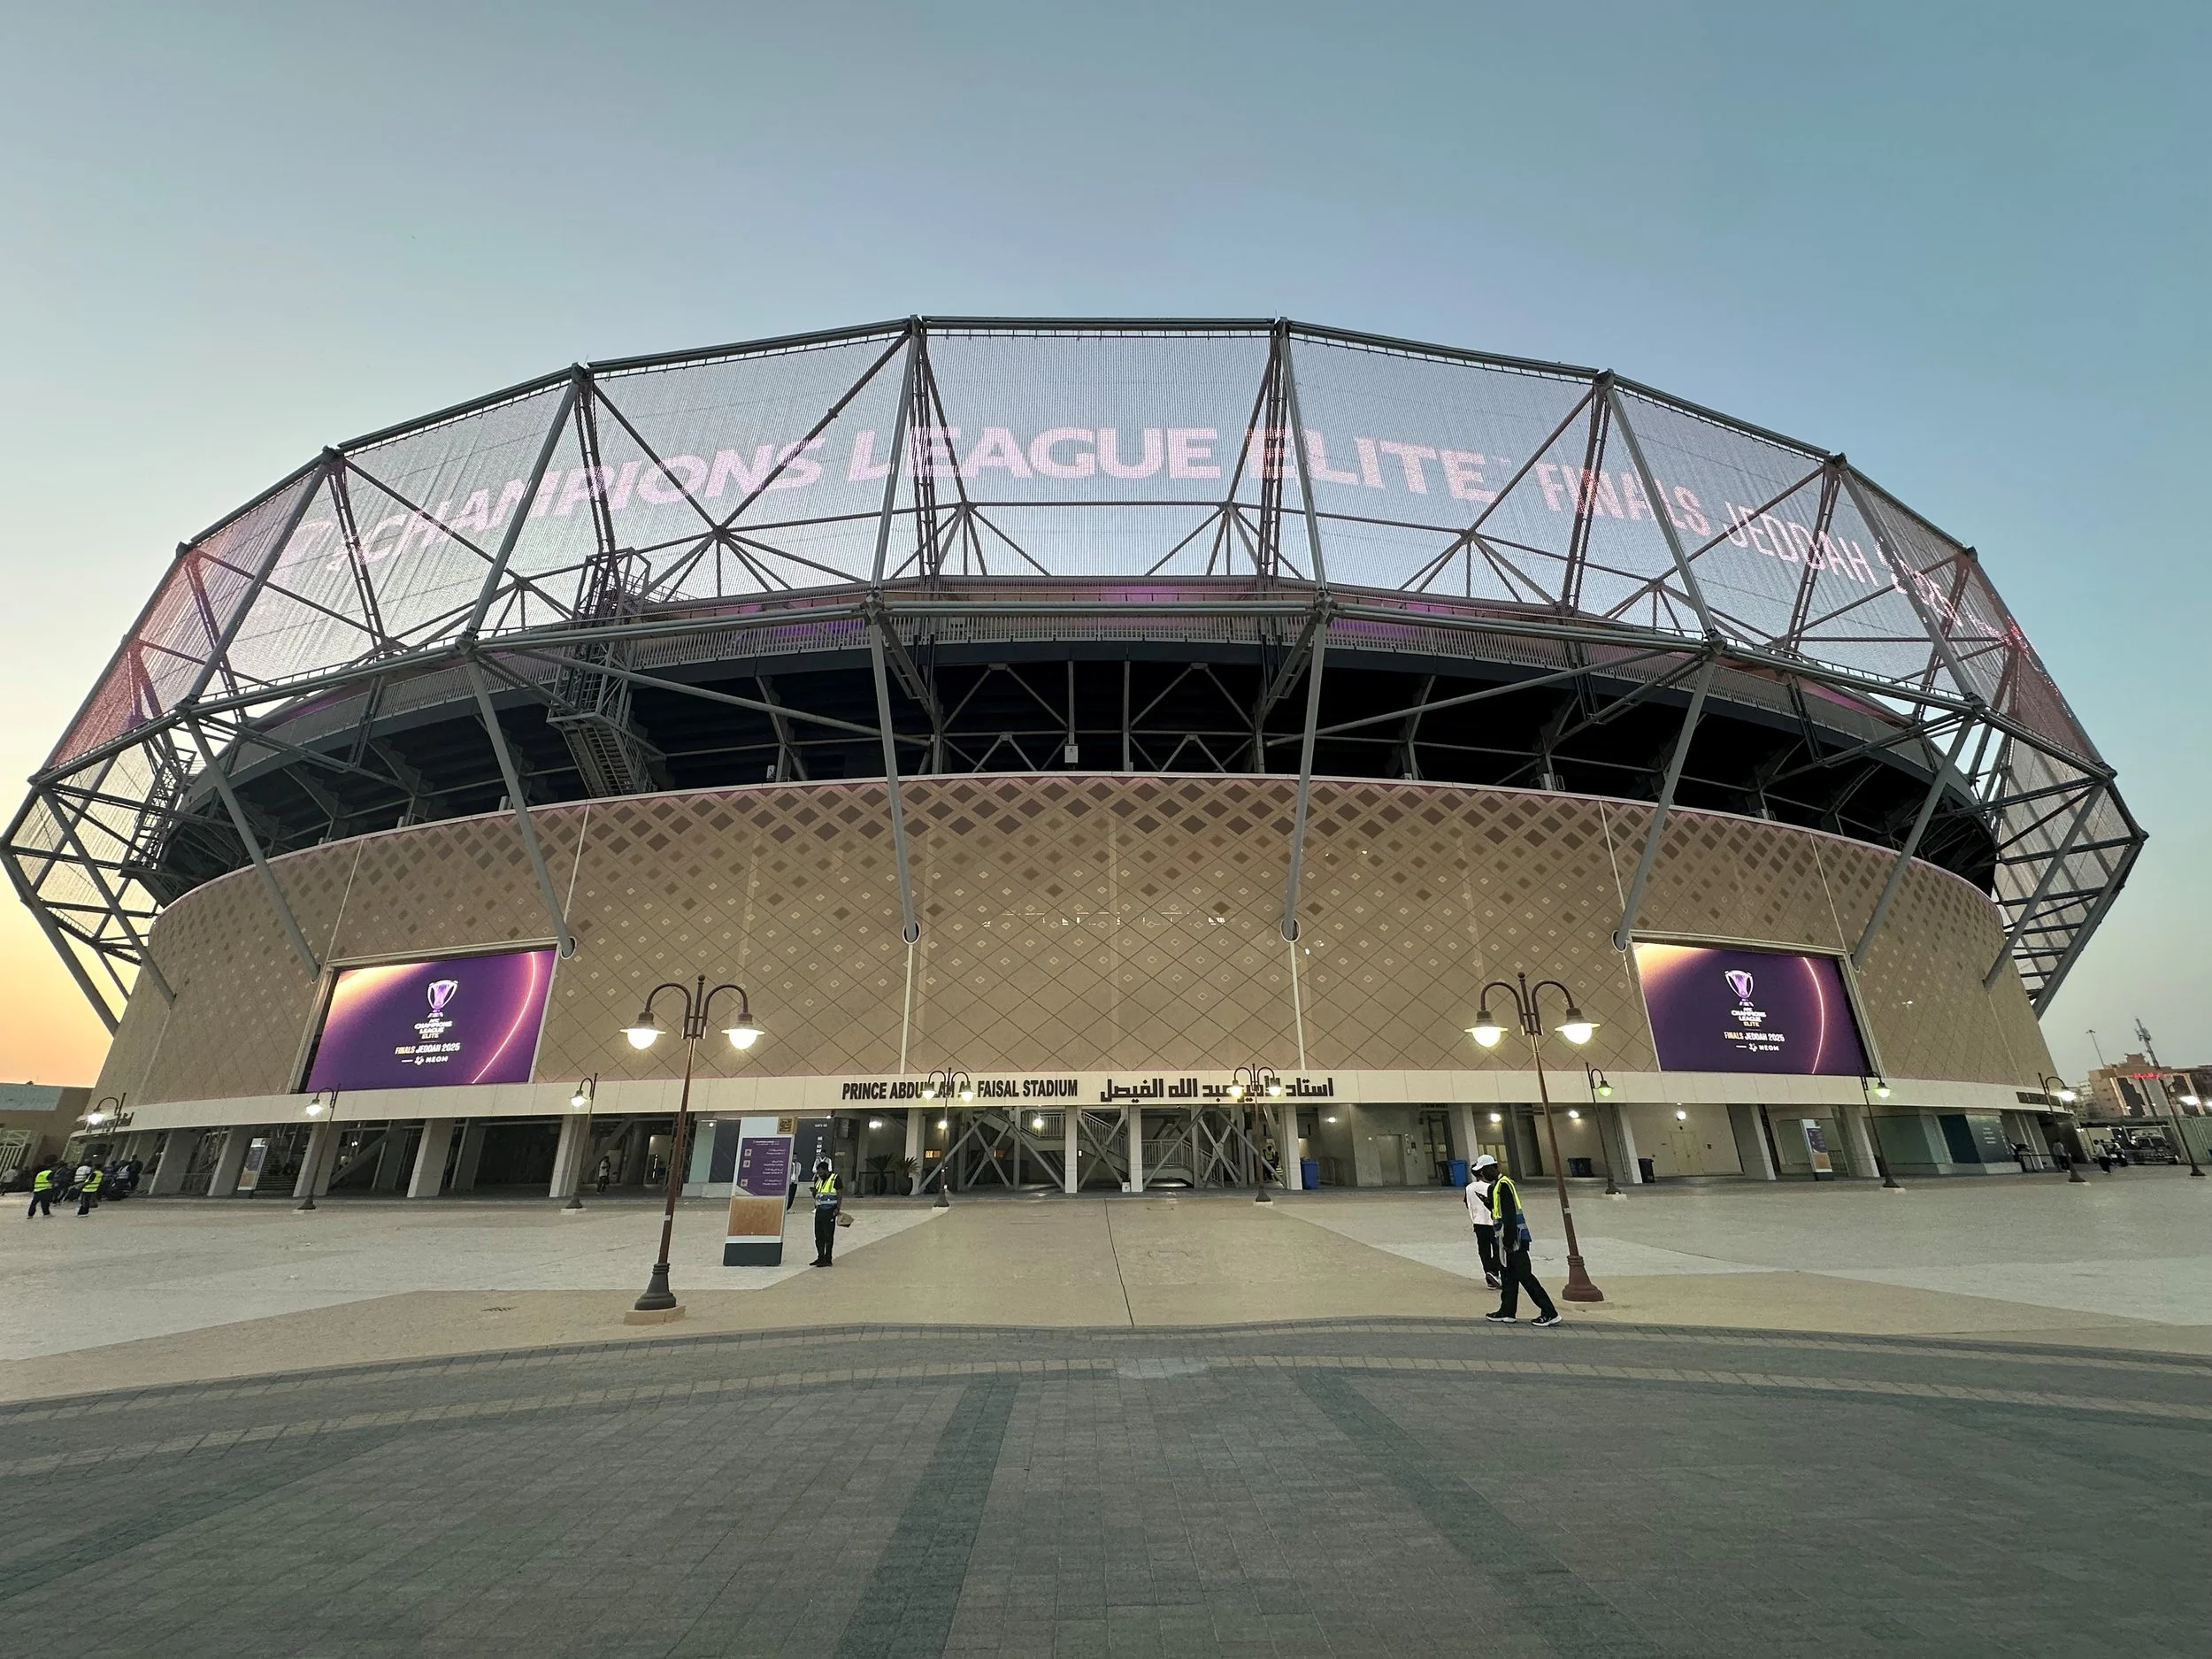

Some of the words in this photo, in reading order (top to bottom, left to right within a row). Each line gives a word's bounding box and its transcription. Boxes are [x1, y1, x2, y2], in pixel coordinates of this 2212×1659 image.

[849, 426, 1220, 481] LEAGUE
[1246, 426, 1499, 503] ELITE
[1536, 463, 1710, 536] FINALS
[1724, 501, 1878, 587] JEDDAH
[442, 1042, 460, 1051] 2025
[842, 1082, 887, 1100] PRINCE
[978, 1080, 1019, 1097] FAISAL
[1023, 1079, 1078, 1097] STADIUM
[1101, 1079, 1164, 1103] الفيصل
[1169, 1079, 1197, 1097] الله
[1286, 1078, 1333, 1096] استاد
